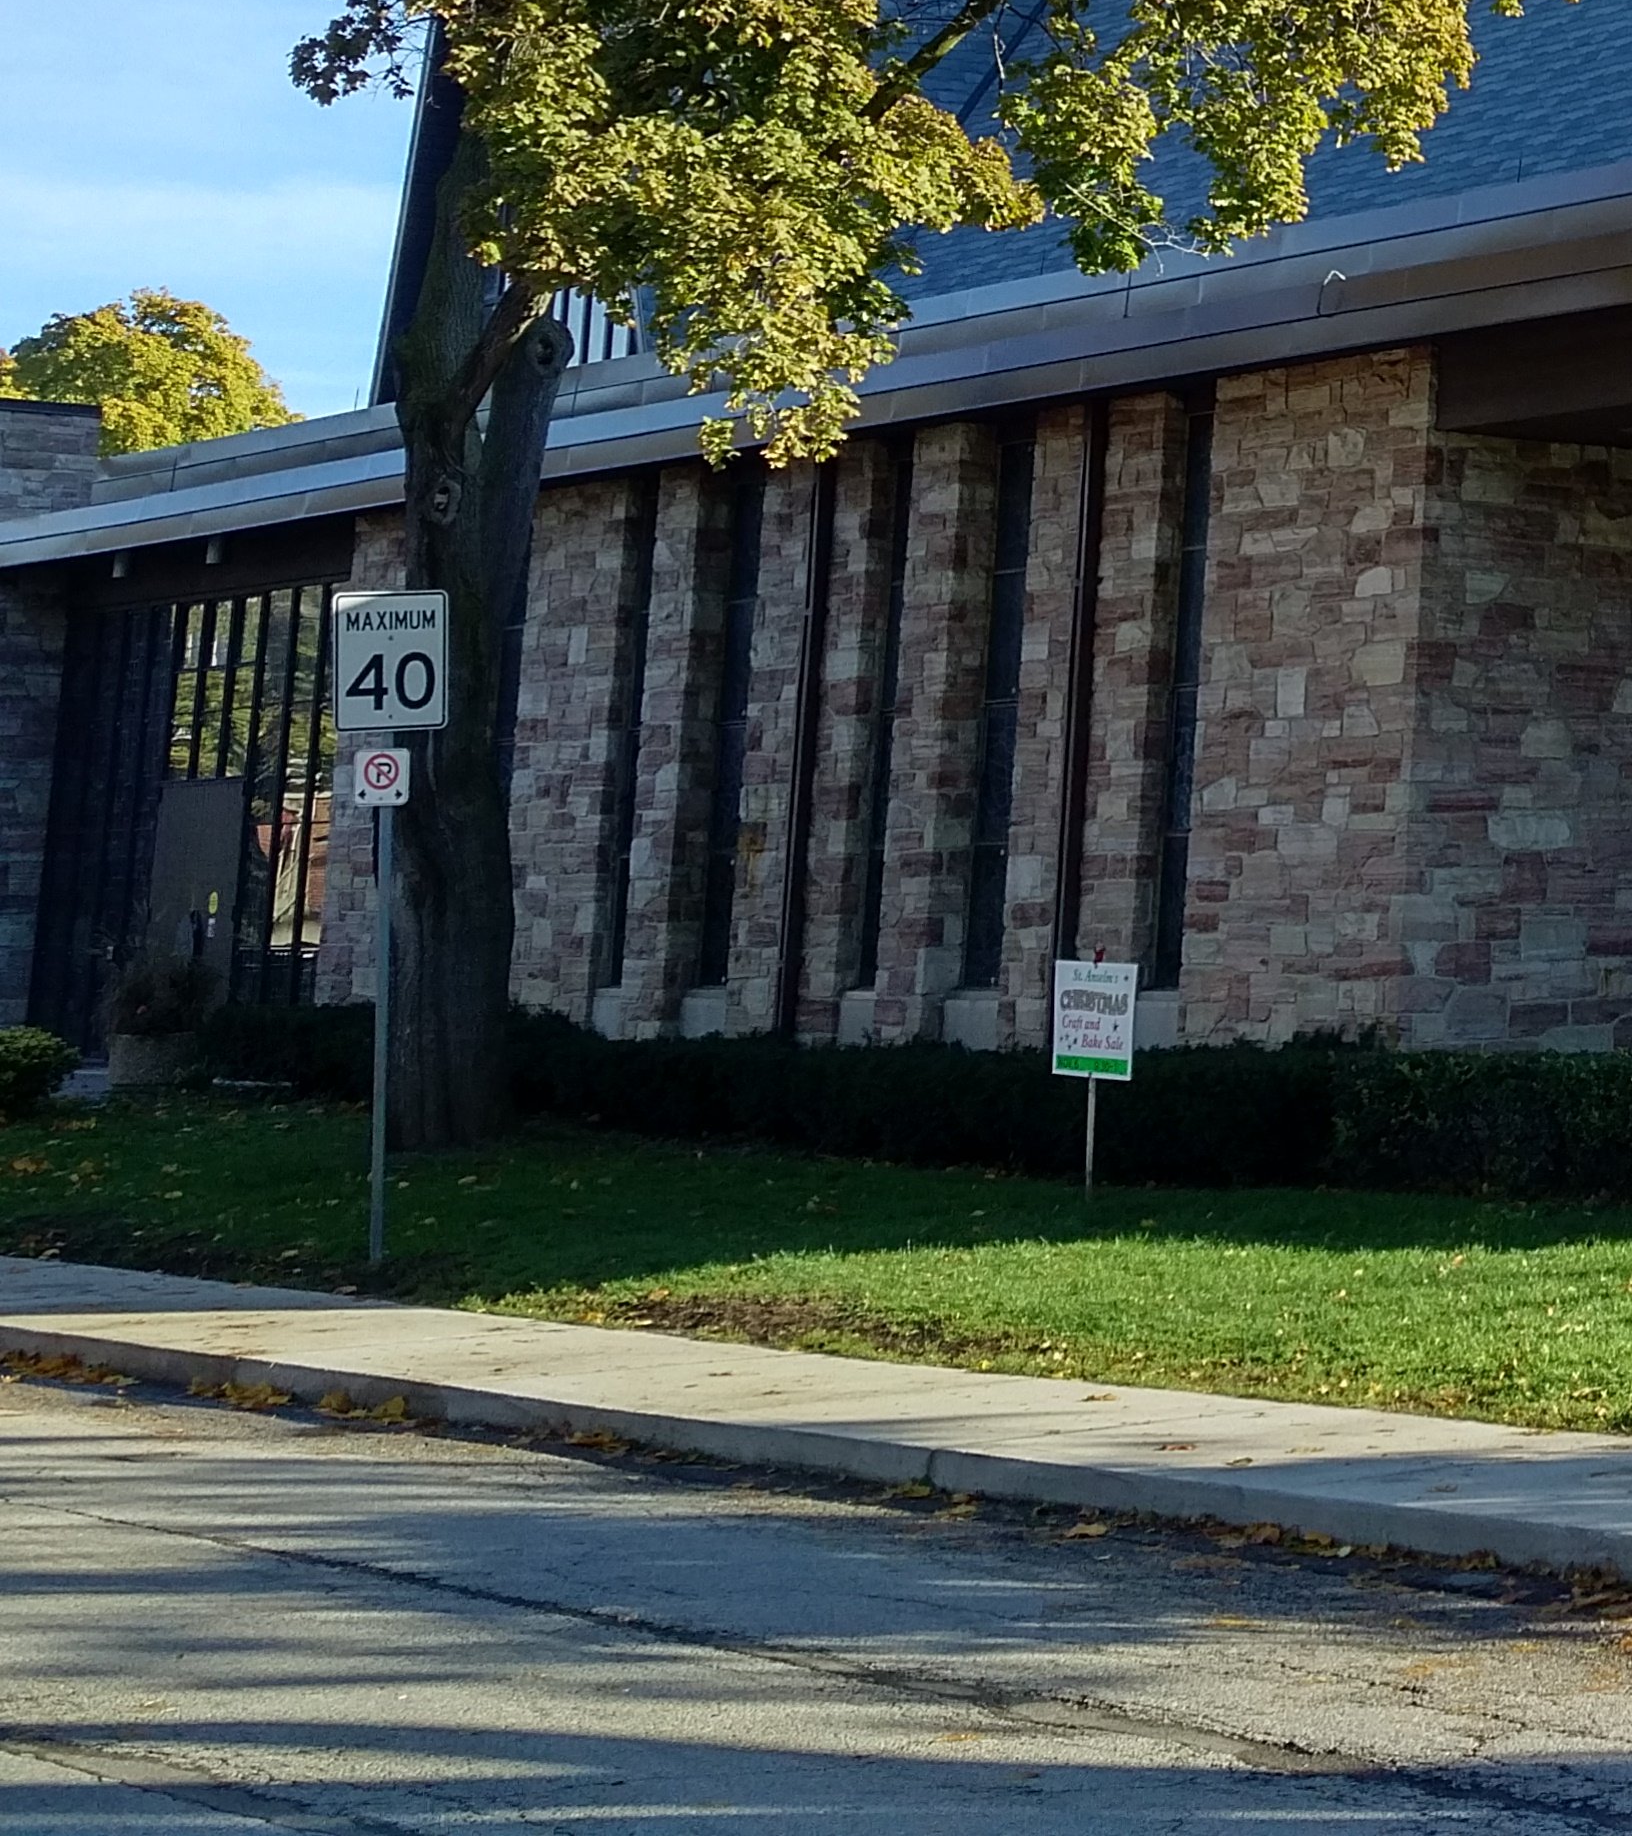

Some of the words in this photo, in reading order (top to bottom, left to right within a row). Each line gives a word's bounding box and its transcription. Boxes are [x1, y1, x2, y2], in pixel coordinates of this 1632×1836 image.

[346, 610, 436, 632] MAXIMUM
[345, 652, 436, 711] 40
[1060, 989, 1129, 1016] CHRISTMAS
[1062, 1015, 1083, 1033] Craft
[1084, 1017, 1101, 1031] and
[1081, 1034, 1103, 1049] Bake
[1104, 1035, 1124, 1050] Sale
